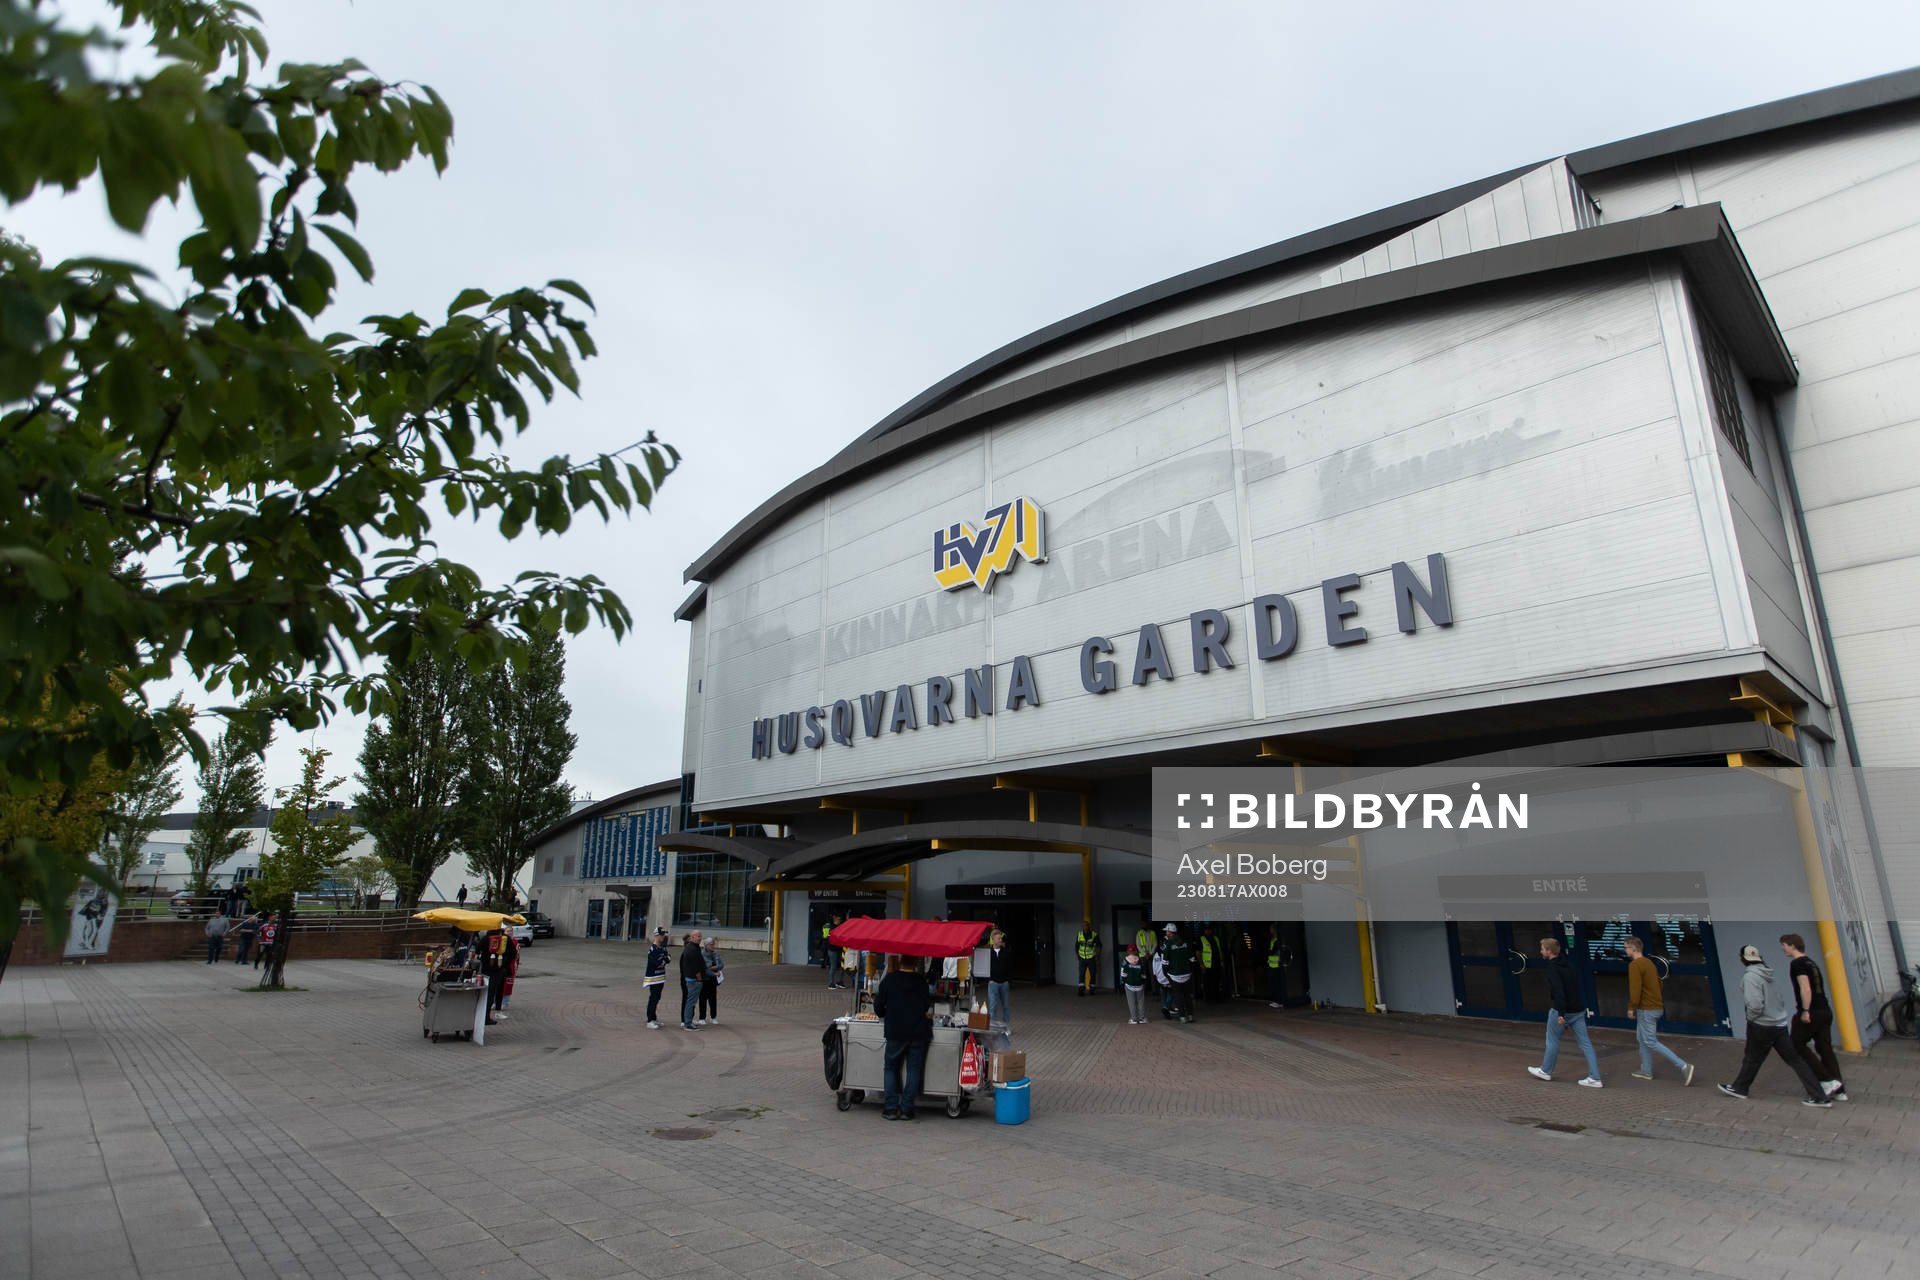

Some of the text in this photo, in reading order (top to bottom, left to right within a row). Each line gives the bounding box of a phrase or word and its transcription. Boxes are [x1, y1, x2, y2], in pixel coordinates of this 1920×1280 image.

[933, 496, 1024, 576] HV71
[1037, 499, 1233, 601] ARENA
[752, 552, 1454, 760] HUSQVARNA GARDEN
[984, 885, 1007, 897] ENTRÉ
[1533, 875, 1589, 893] ENTRÉ
